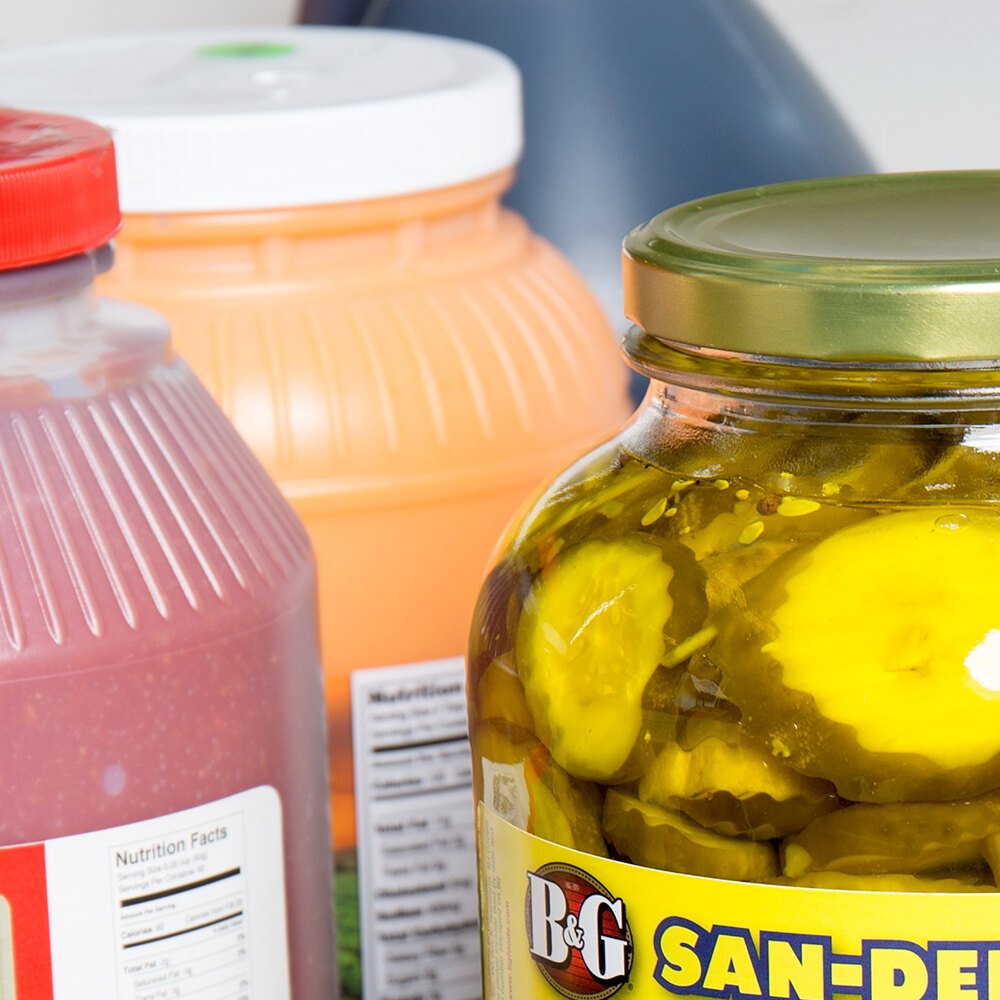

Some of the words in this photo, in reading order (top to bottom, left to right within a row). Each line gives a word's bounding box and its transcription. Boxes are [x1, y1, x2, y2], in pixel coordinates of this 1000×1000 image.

[116, 840, 185, 867] Nutrition
[191, 827, 228, 848] Facts
[527, 871, 630, 983] B&G
